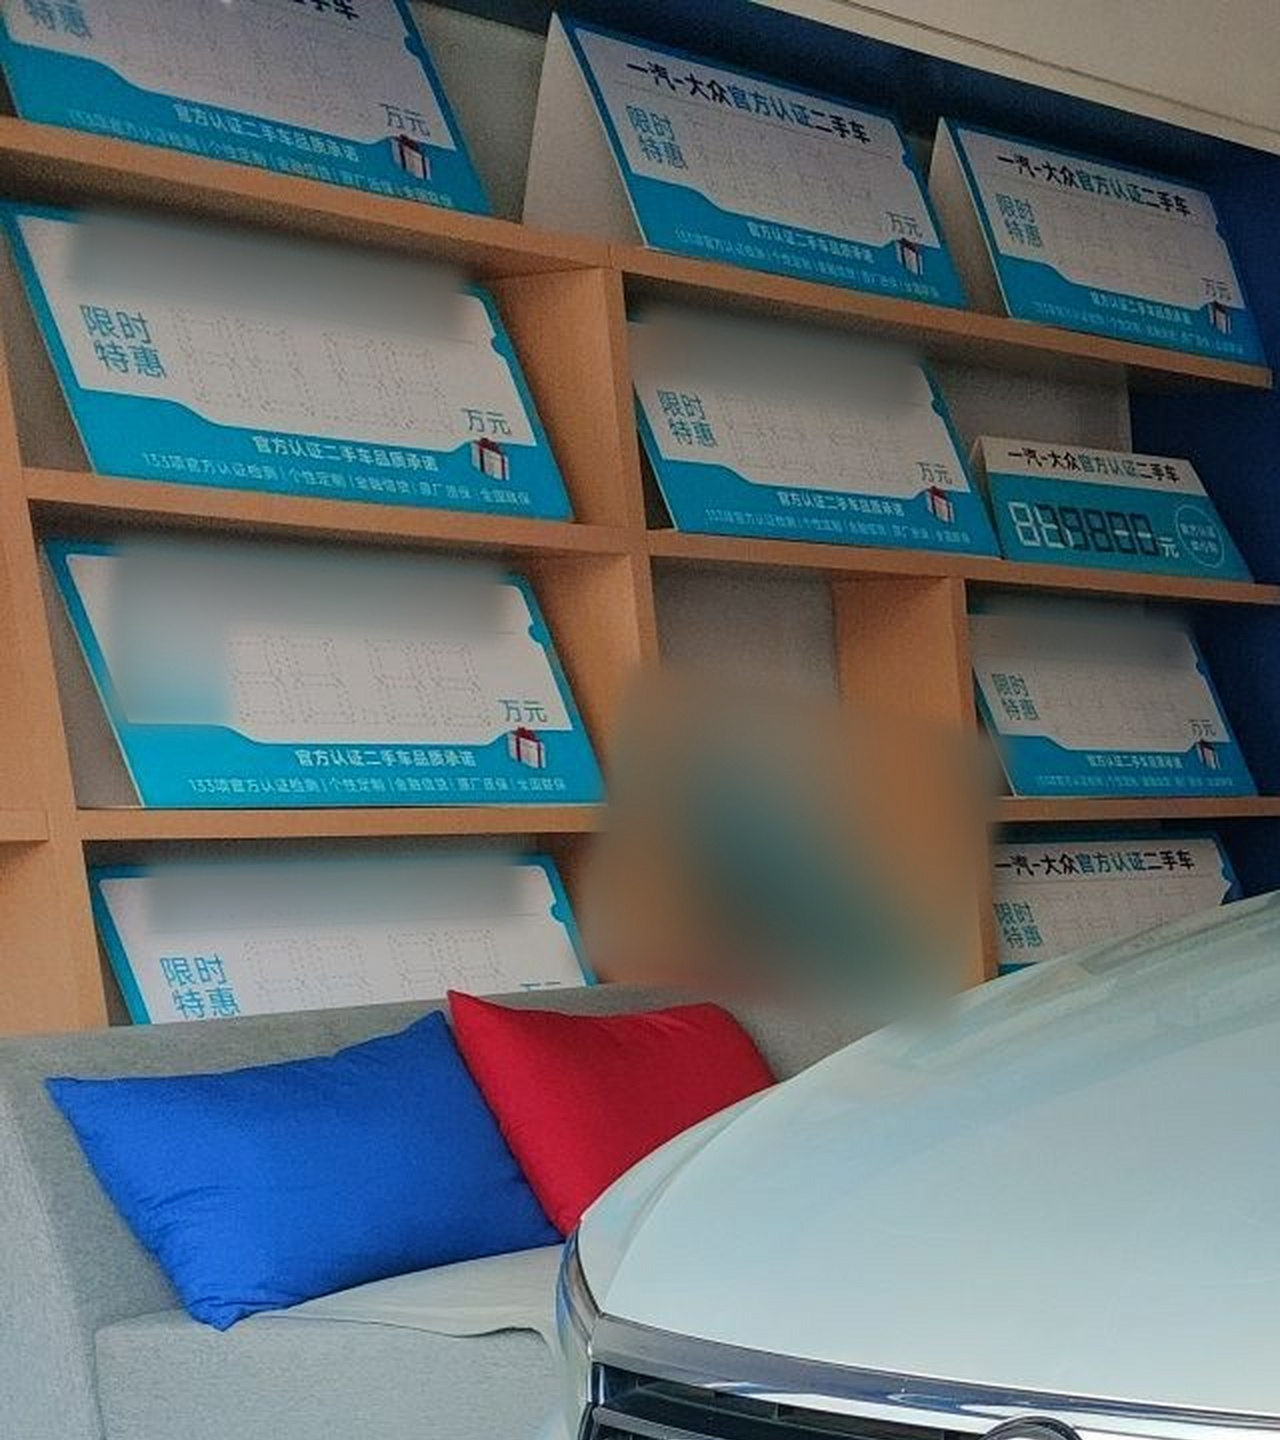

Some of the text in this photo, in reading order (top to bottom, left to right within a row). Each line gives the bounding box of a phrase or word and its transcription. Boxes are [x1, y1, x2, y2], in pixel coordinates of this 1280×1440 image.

[627, 61, 870, 144] 一汽-大众官方认证二手车
[375, 102, 432, 138] 万元
[627, 104, 677, 141] 限时
[996, 154, 1191, 217] 一汽-大众官方认证二手车
[884, 211, 923, 238] 万元
[80, 304, 151, 344] 限时
[94, 340, 166, 379] 特惠
[656, 389, 706, 421] 限时
[463, 409, 512, 436] 万元
[917, 461, 953, 485] 万元
[1007, 447, 1180, 483] 一汽-大众官方认证二手车
[1157, 536, 1179, 559] 元
[501, 700, 548, 723] 万元
[994, 850, 1195, 877] 一汽-大众官方认证二手车
[160, 953, 227, 987] 限时
[172, 987, 241, 1019] 特惠
